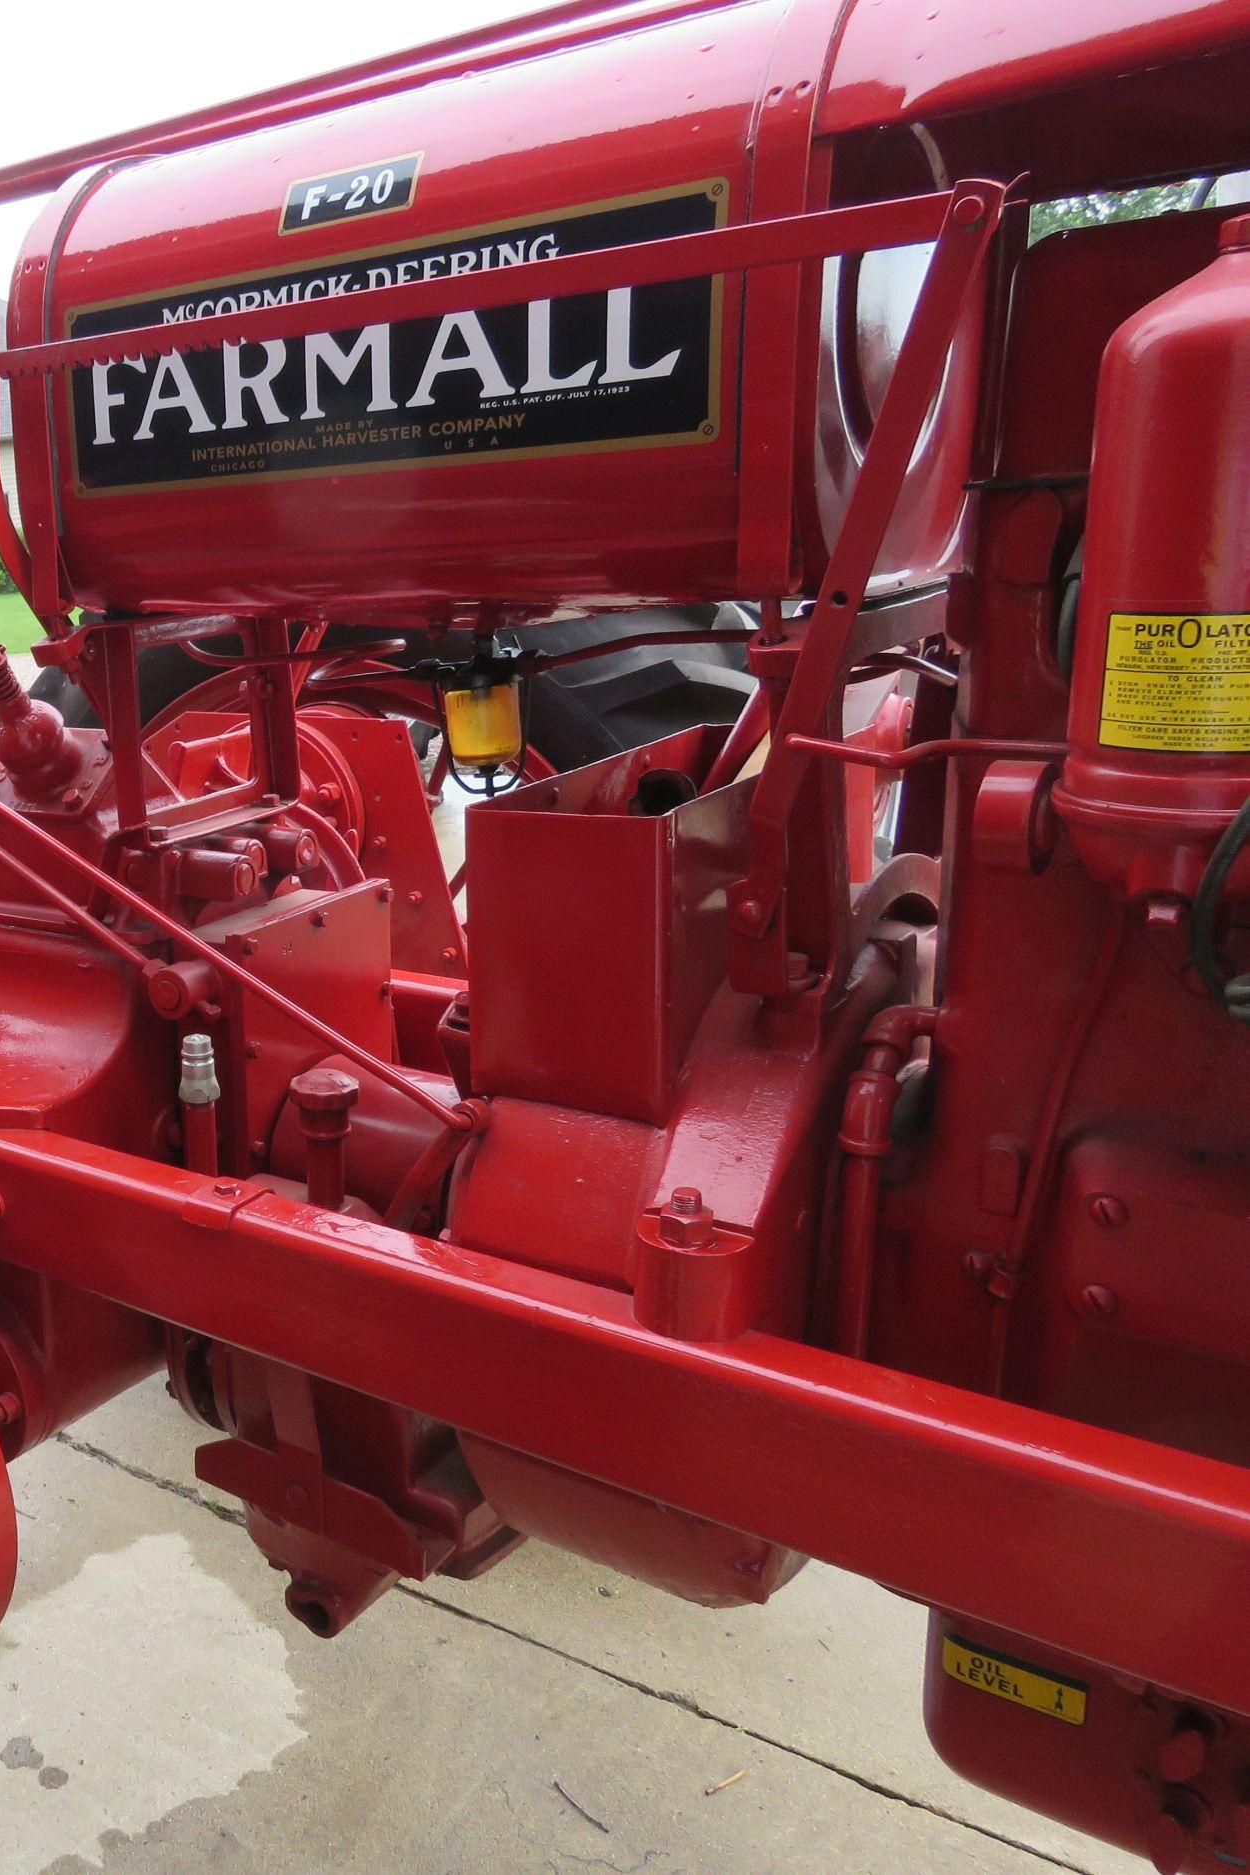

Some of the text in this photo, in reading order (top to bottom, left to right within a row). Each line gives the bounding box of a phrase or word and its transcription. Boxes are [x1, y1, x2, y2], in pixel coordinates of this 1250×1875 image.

[301, 169, 394, 220] F-20
[92, 286, 682, 445] FARMALL
[480, 401, 500, 409] REG.
[503, 398, 520, 407] U.S.
[523, 395, 543, 404] PAT.
[545, 393, 565, 402] OFF.
[567, 390, 591, 399] JULY
[315, 419, 374, 433] MADE BY
[192, 413, 526, 462] INTERNATIONAL HARVESTER COMPANY
[210, 460, 265, 473] CHICAGO
[1134, 640, 1153, 648] THE
[1157, 640, 1176, 648] OIL
[1119, 655, 1176, 663] PUROLATOR
[971, 1657, 1006, 1679] OIL
[956, 1662, 1024, 1699] LEVEL
